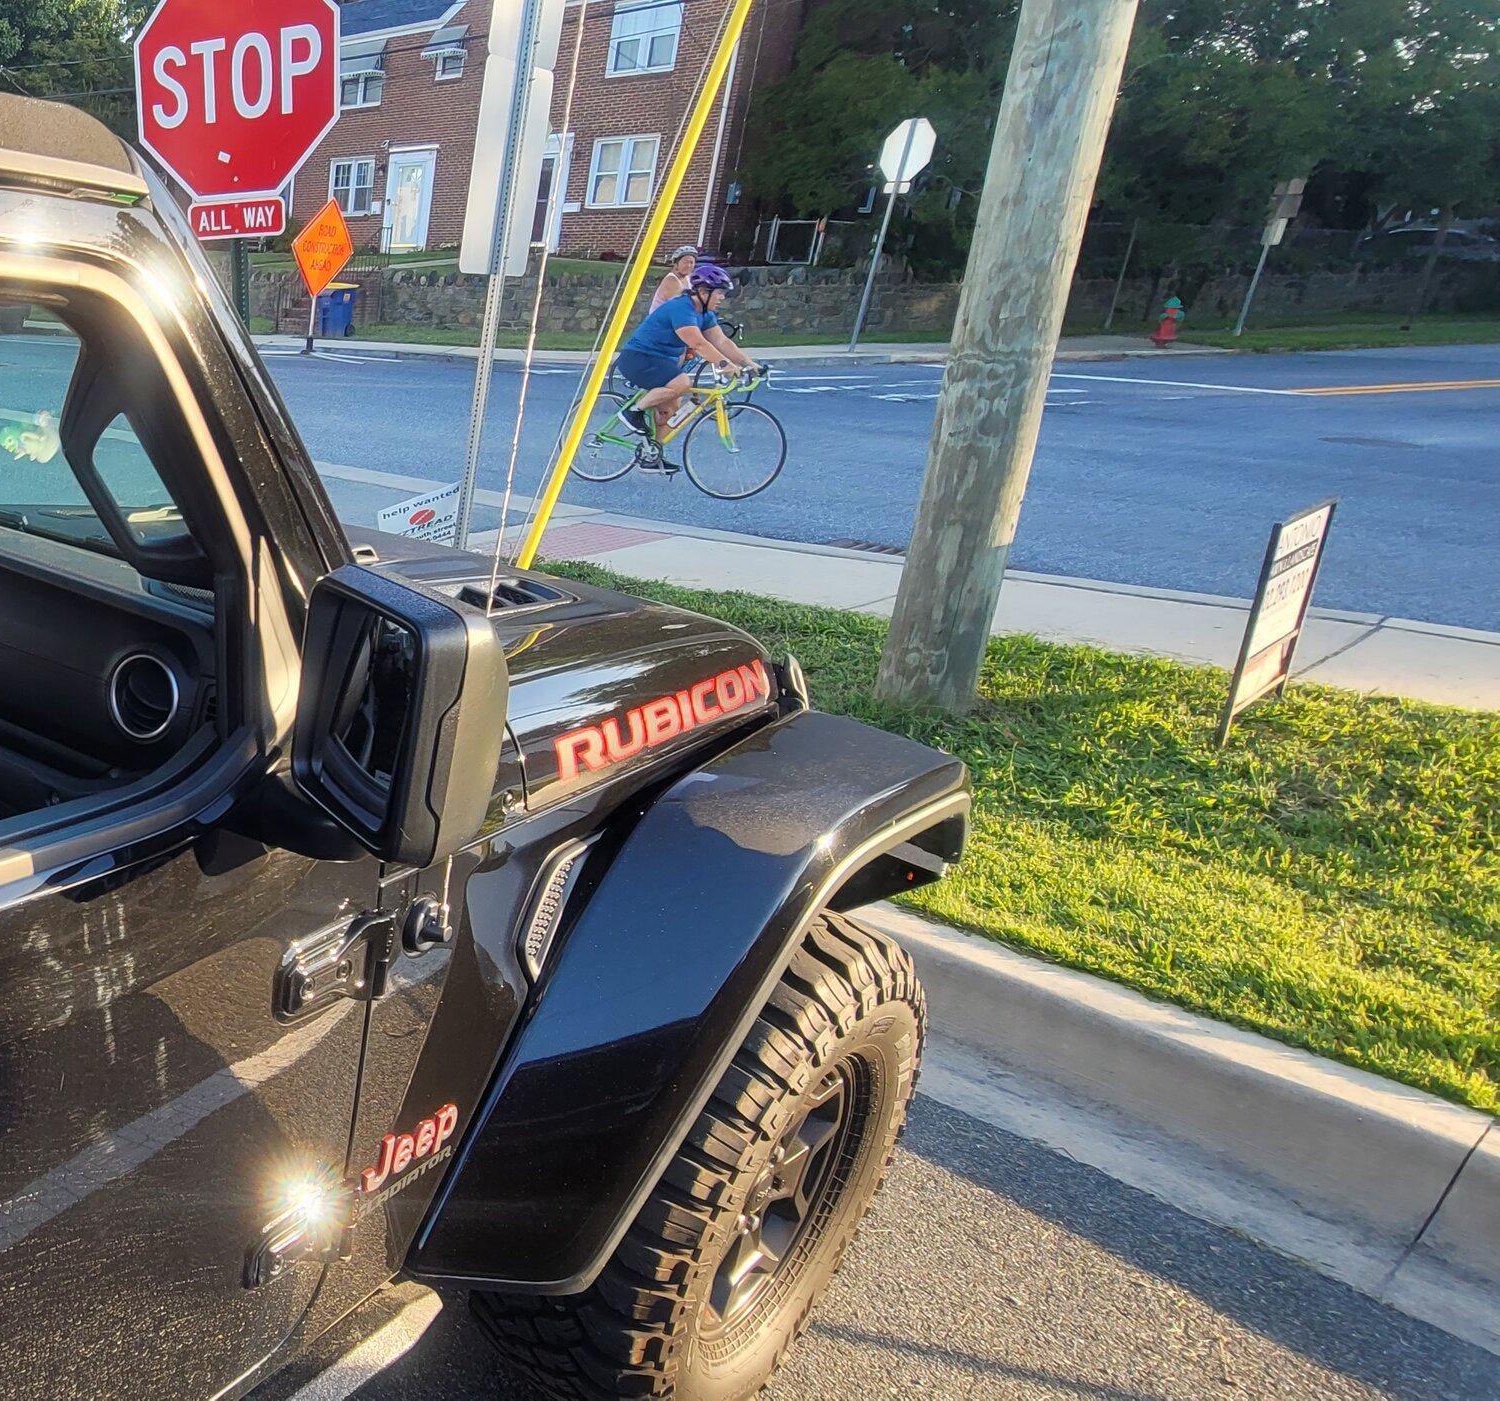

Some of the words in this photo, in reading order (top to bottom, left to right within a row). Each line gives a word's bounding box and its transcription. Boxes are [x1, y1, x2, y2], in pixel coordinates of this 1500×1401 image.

[153, 23, 322, 129] STOP
[199, 208, 231, 232] ALL
[243, 205, 275, 229] WAY
[382, 506, 410, 519] help
[413, 486, 460, 507] wanted
[554, 658, 770, 781] RUBICON
[361, 1103, 458, 1194] Jeep
